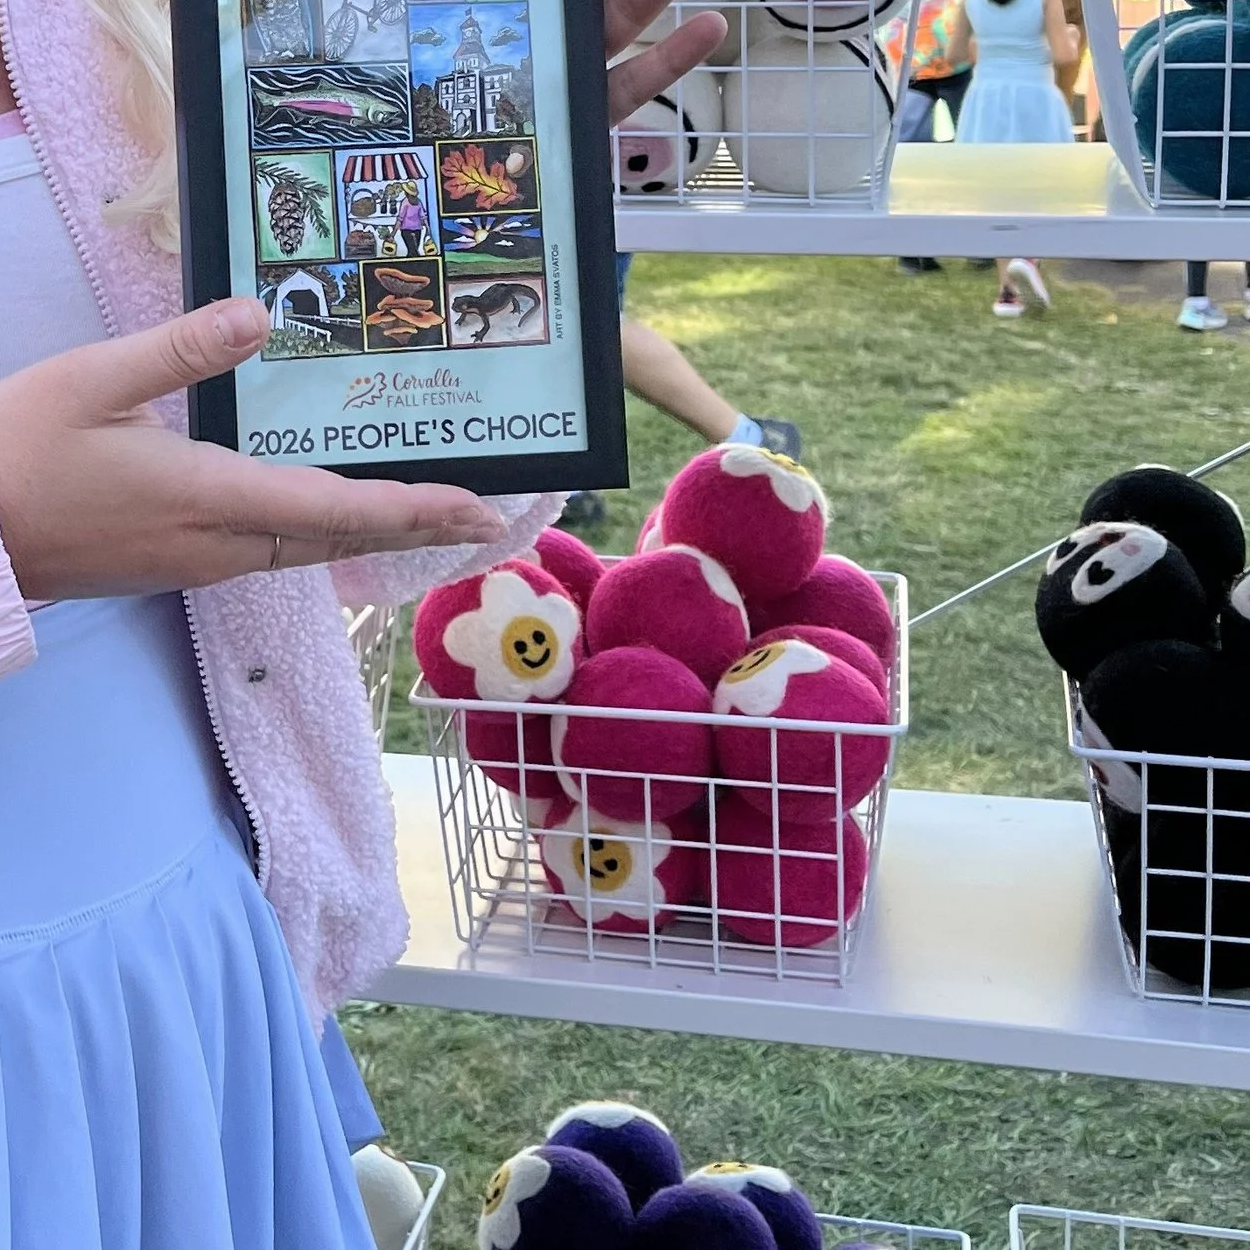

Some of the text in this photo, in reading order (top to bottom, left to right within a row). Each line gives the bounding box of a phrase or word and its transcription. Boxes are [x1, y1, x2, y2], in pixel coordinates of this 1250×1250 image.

[392, 368, 461, 392] Corvallis
[386, 390, 482, 408] FALL FESTIVAL
[248, 411, 578, 457] 2026 PEOPLE'S CHOICE
